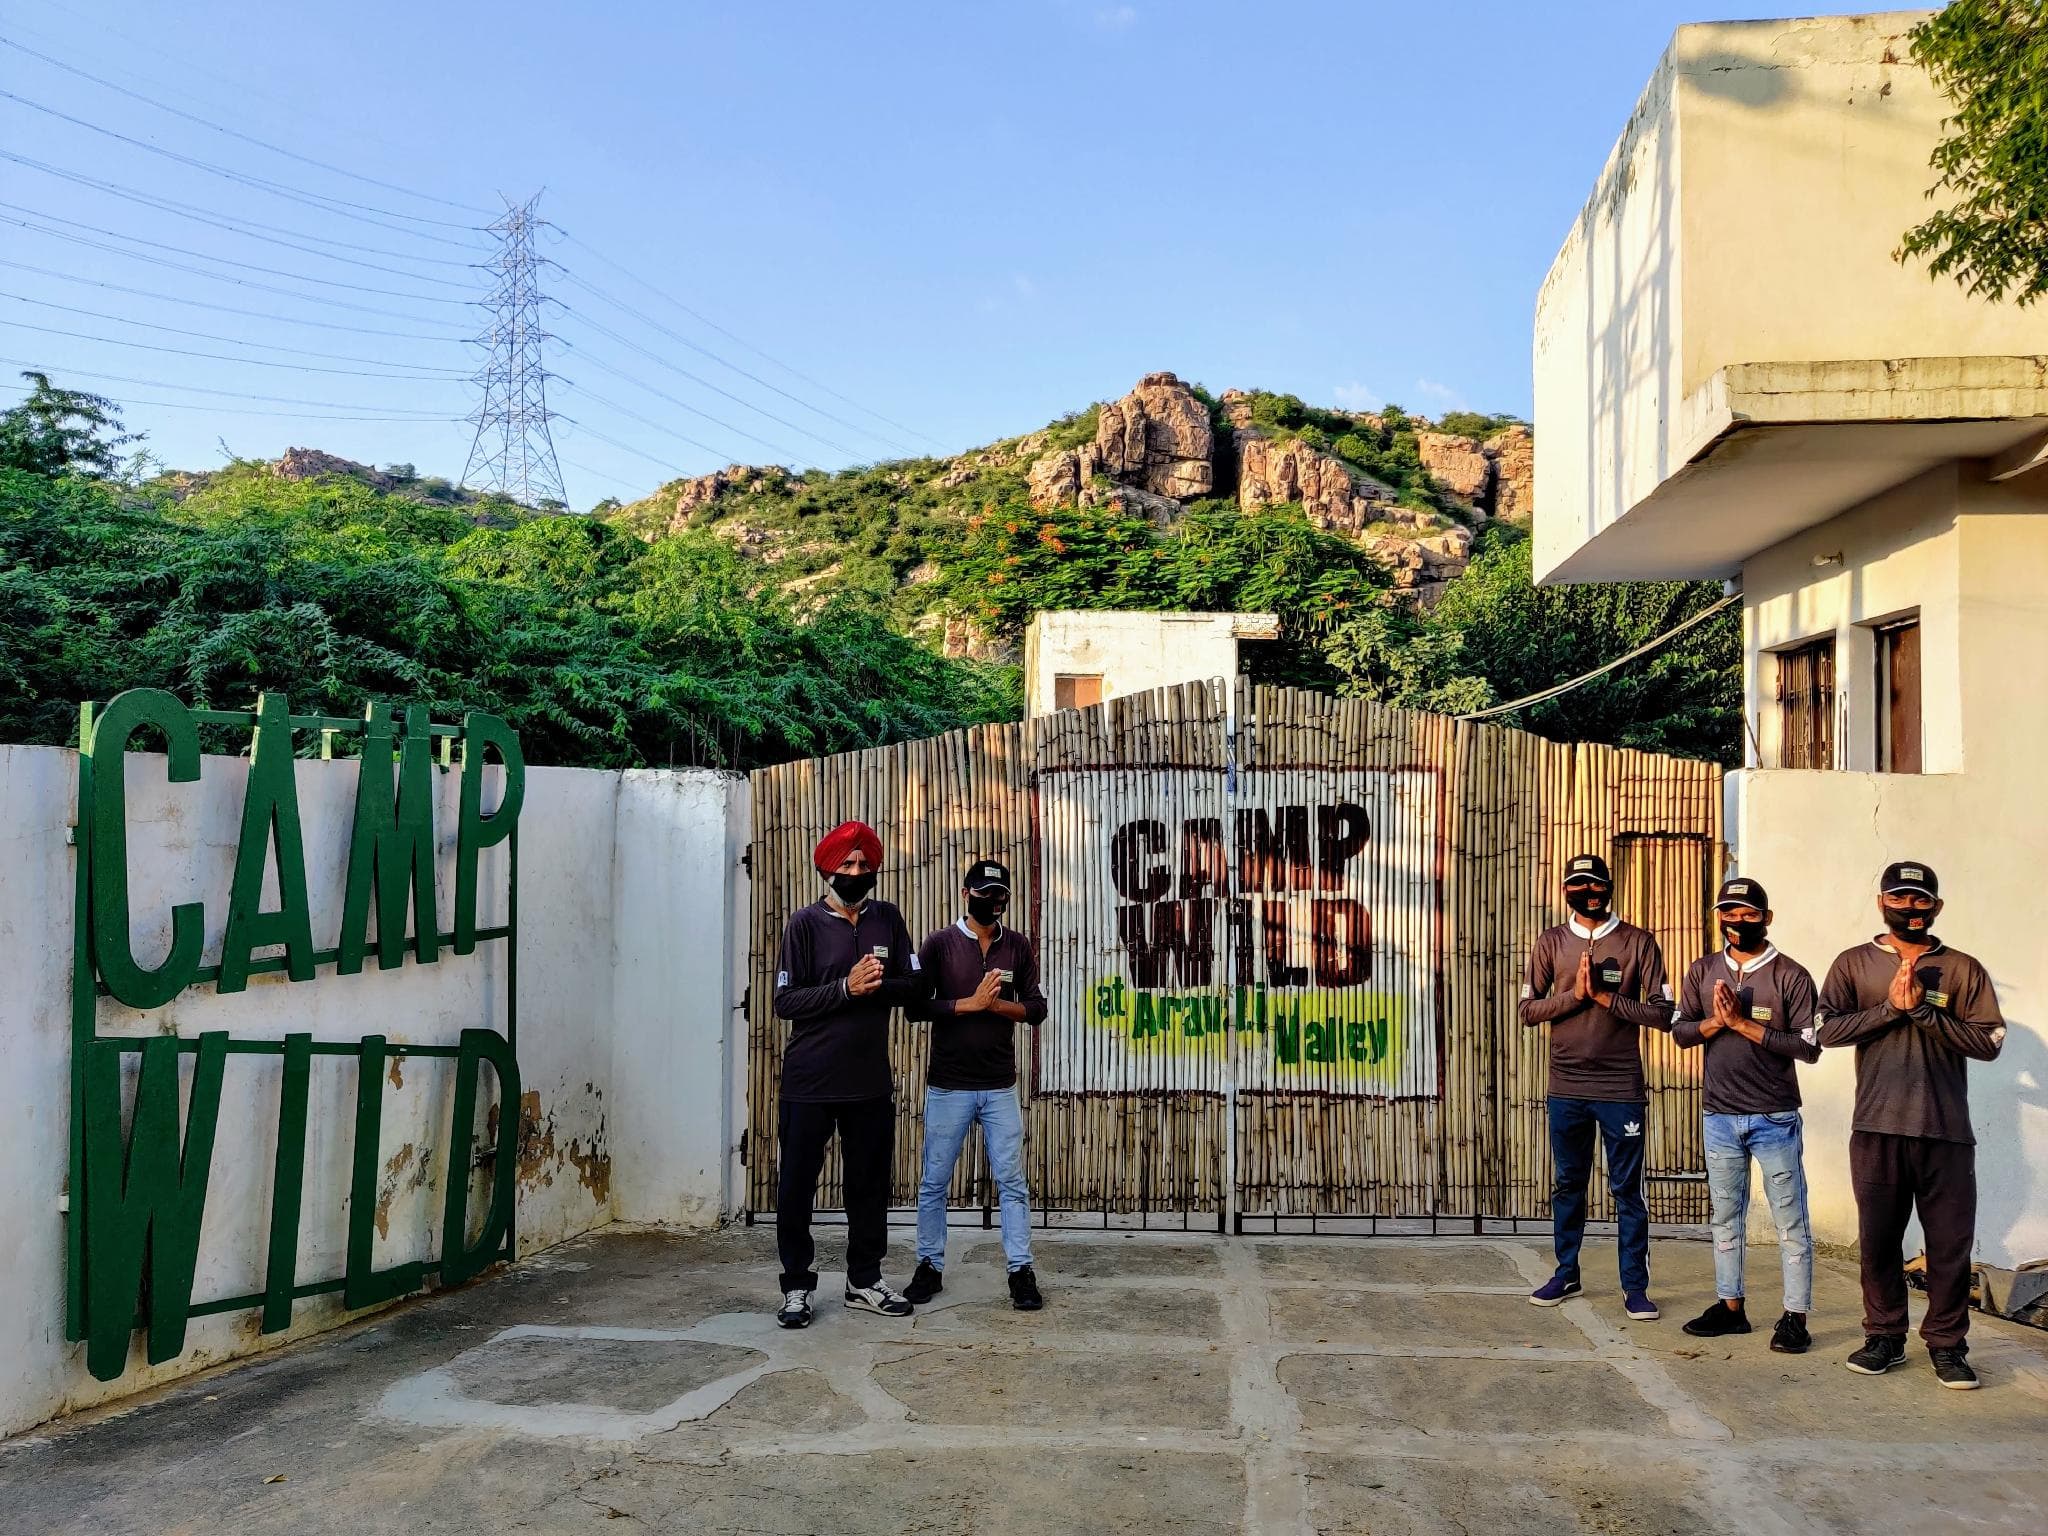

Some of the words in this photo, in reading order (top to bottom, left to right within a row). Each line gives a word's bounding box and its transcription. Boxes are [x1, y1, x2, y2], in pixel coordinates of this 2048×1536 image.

[91, 688, 524, 1009] CAMP
[1111, 803, 1370, 902] CAMP
[1115, 898, 1372, 988] WILD
[1097, 976, 1125, 1018] at
[1276, 998, 1388, 1064] Valley
[84, 1029, 521, 1381] WILD
